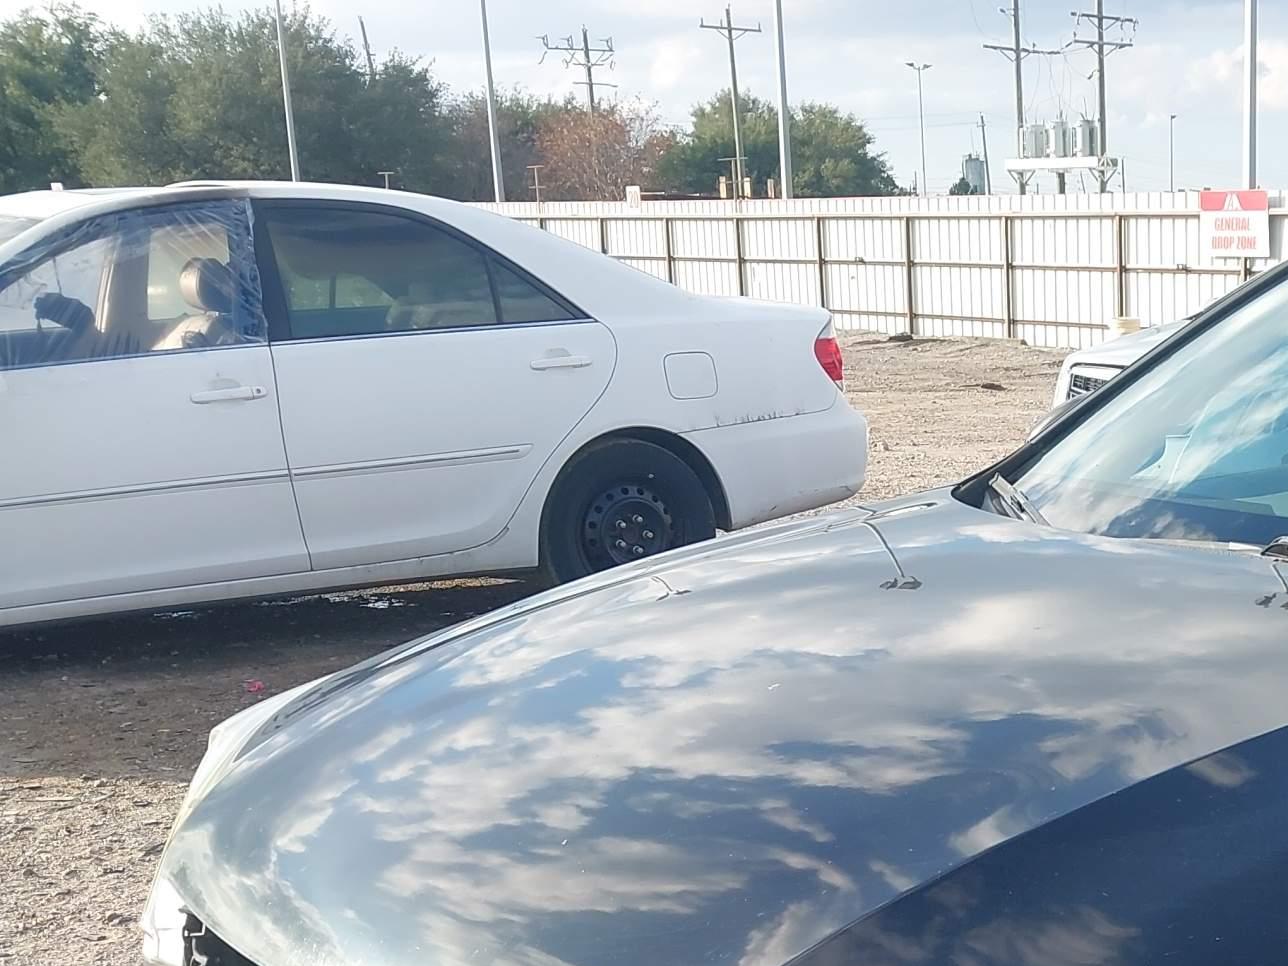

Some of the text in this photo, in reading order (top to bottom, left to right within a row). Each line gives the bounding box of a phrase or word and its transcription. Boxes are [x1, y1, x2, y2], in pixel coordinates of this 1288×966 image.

[1214, 216, 1250, 231] GENERAL
[1211, 235, 1256, 250] DROP ZONE
